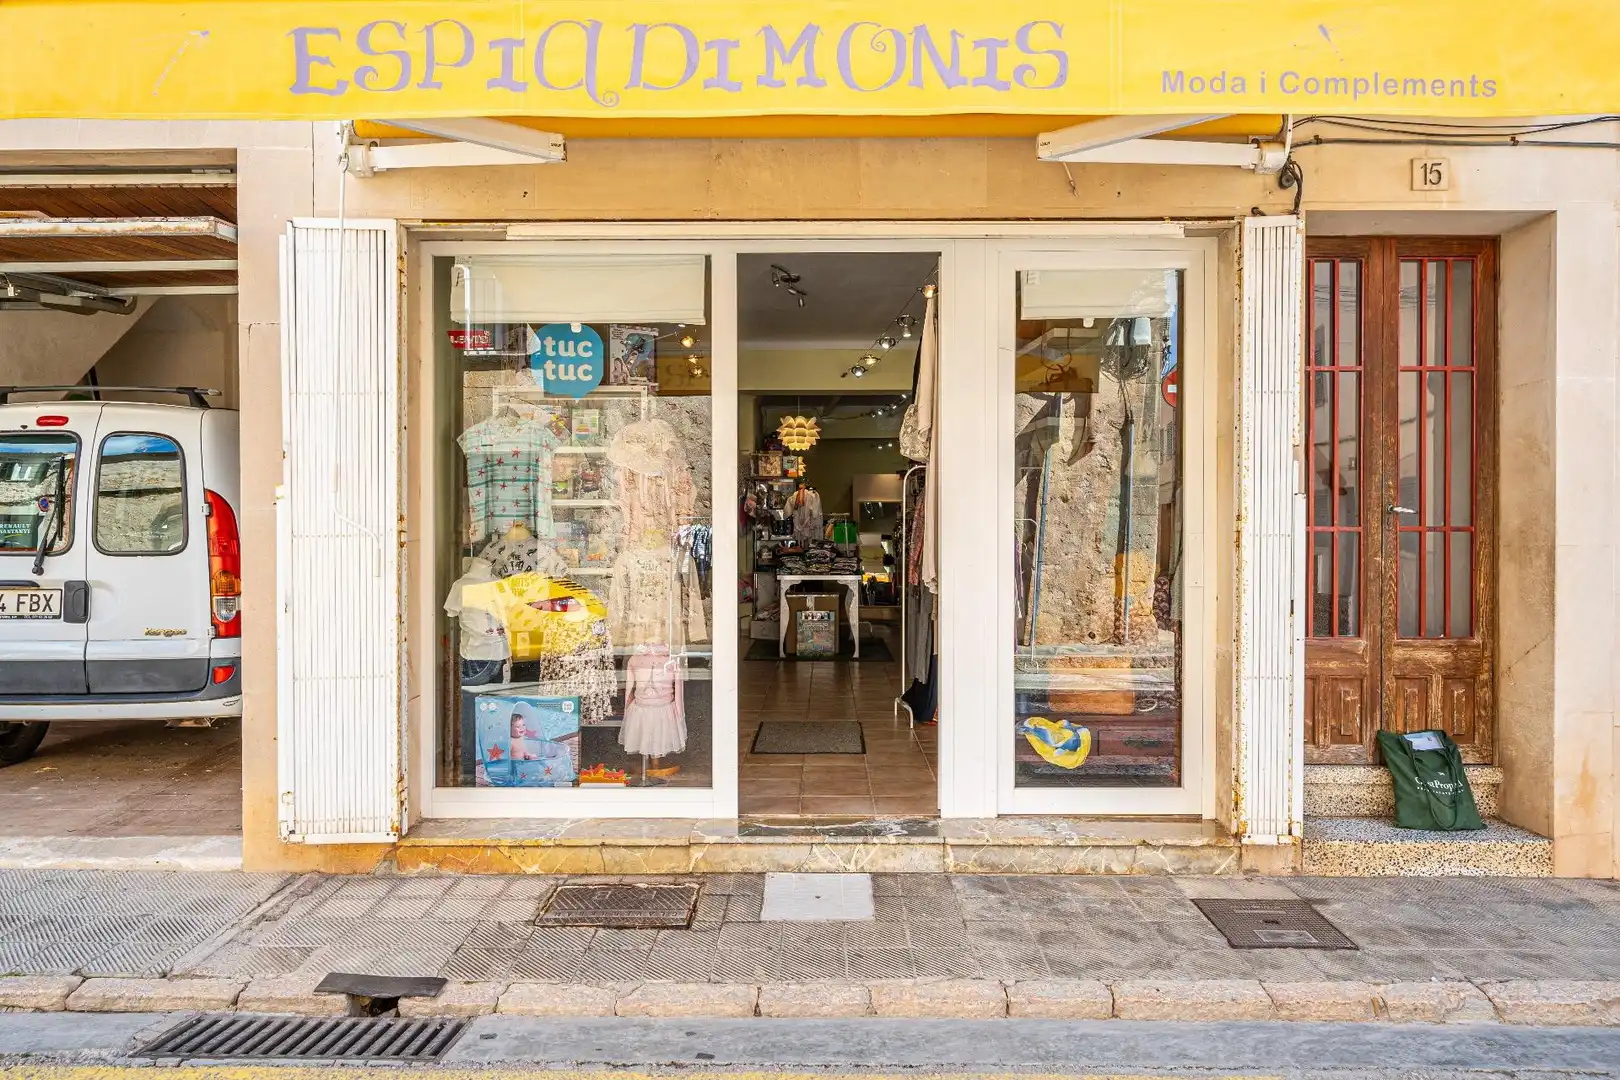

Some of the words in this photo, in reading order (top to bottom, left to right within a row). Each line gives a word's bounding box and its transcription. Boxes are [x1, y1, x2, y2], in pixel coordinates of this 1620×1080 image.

[1161, 70, 1248, 94] Moda
[1260, 71, 1267, 94] i
[1279, 71, 1498, 100] Complements
[1419, 162, 1443, 186] 15
[543, 336, 593, 358] tuc
[543, 359, 593, 382] tuc
[16, 593, 54, 613] FBX
